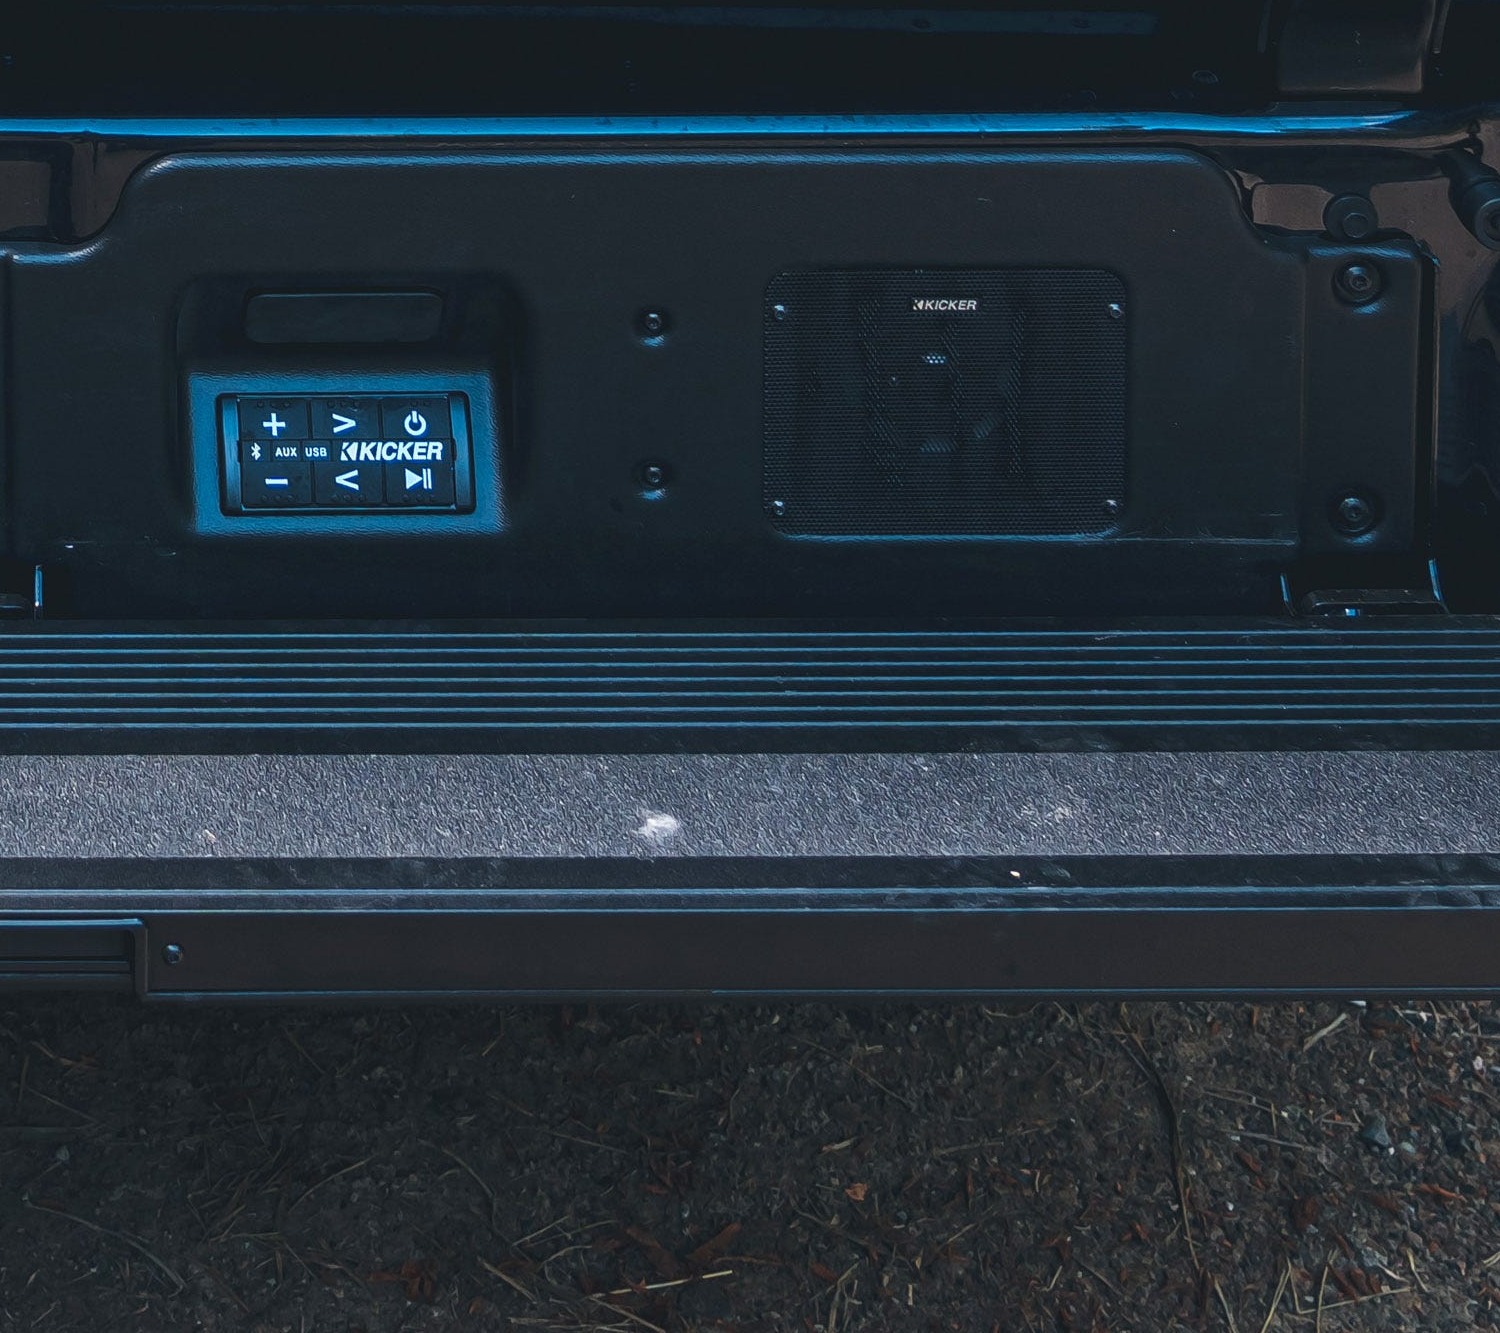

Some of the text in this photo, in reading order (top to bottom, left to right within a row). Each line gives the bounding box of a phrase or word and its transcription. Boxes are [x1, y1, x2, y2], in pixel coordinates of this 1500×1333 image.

[924, 299, 977, 311] KICKER
[275, 441, 443, 462] AUX USB KICKER
